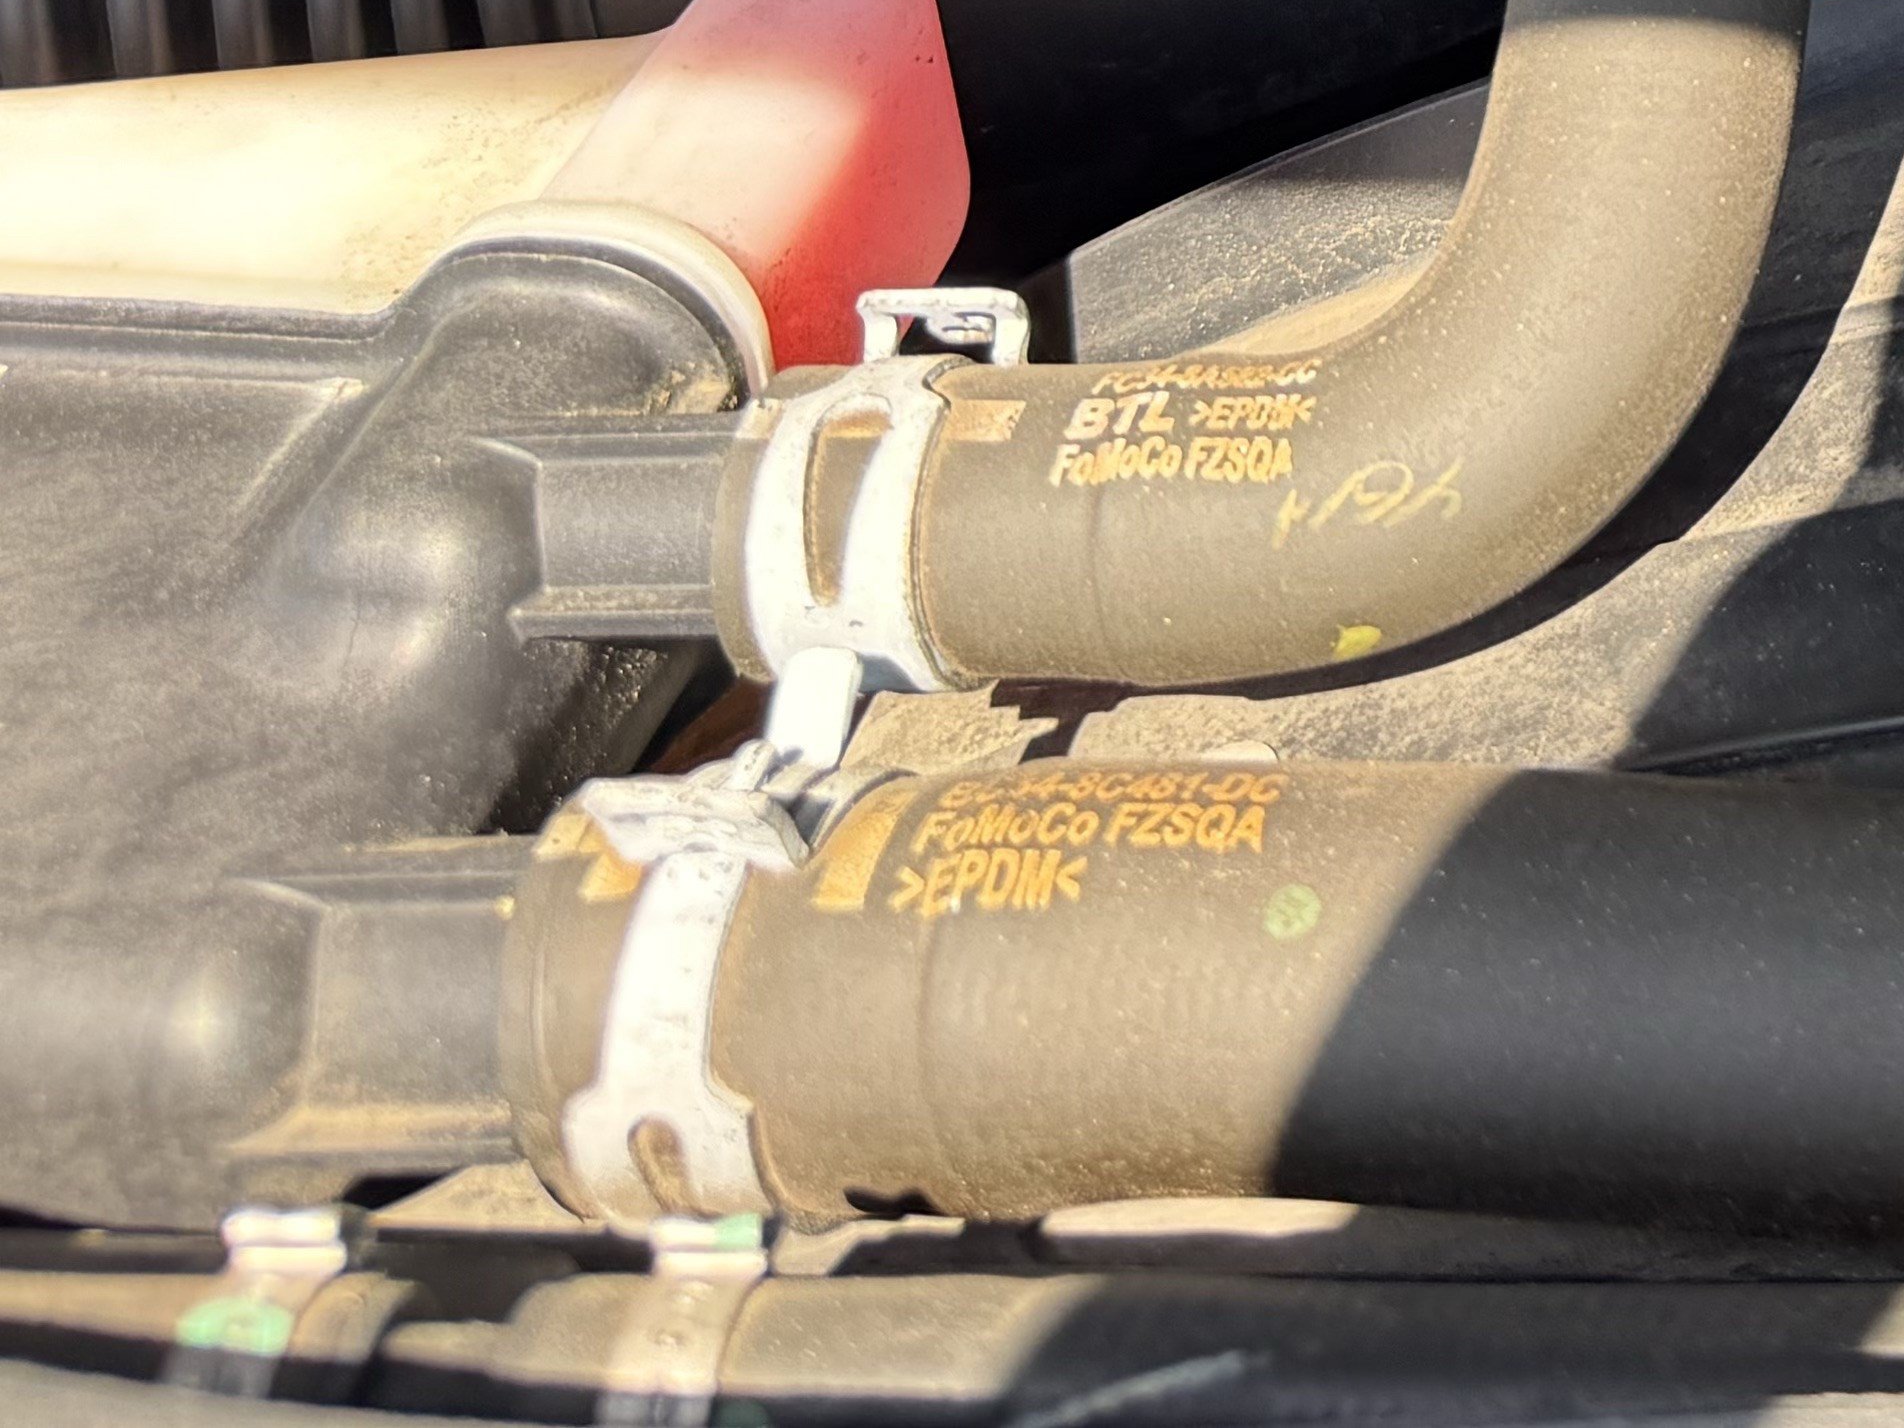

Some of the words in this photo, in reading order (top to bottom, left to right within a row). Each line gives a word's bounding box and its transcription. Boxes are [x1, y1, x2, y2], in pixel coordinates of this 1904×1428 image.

[1063, 390, 1175, 441] BTL
[1049, 435, 1183, 487] FoMoCo
[1183, 435, 1293, 484] FZSQA
[912, 802, 1100, 854] FoMoCo
[1102, 801, 1267, 854] FZSQA
[888, 848, 1088, 920] >EPDM<
